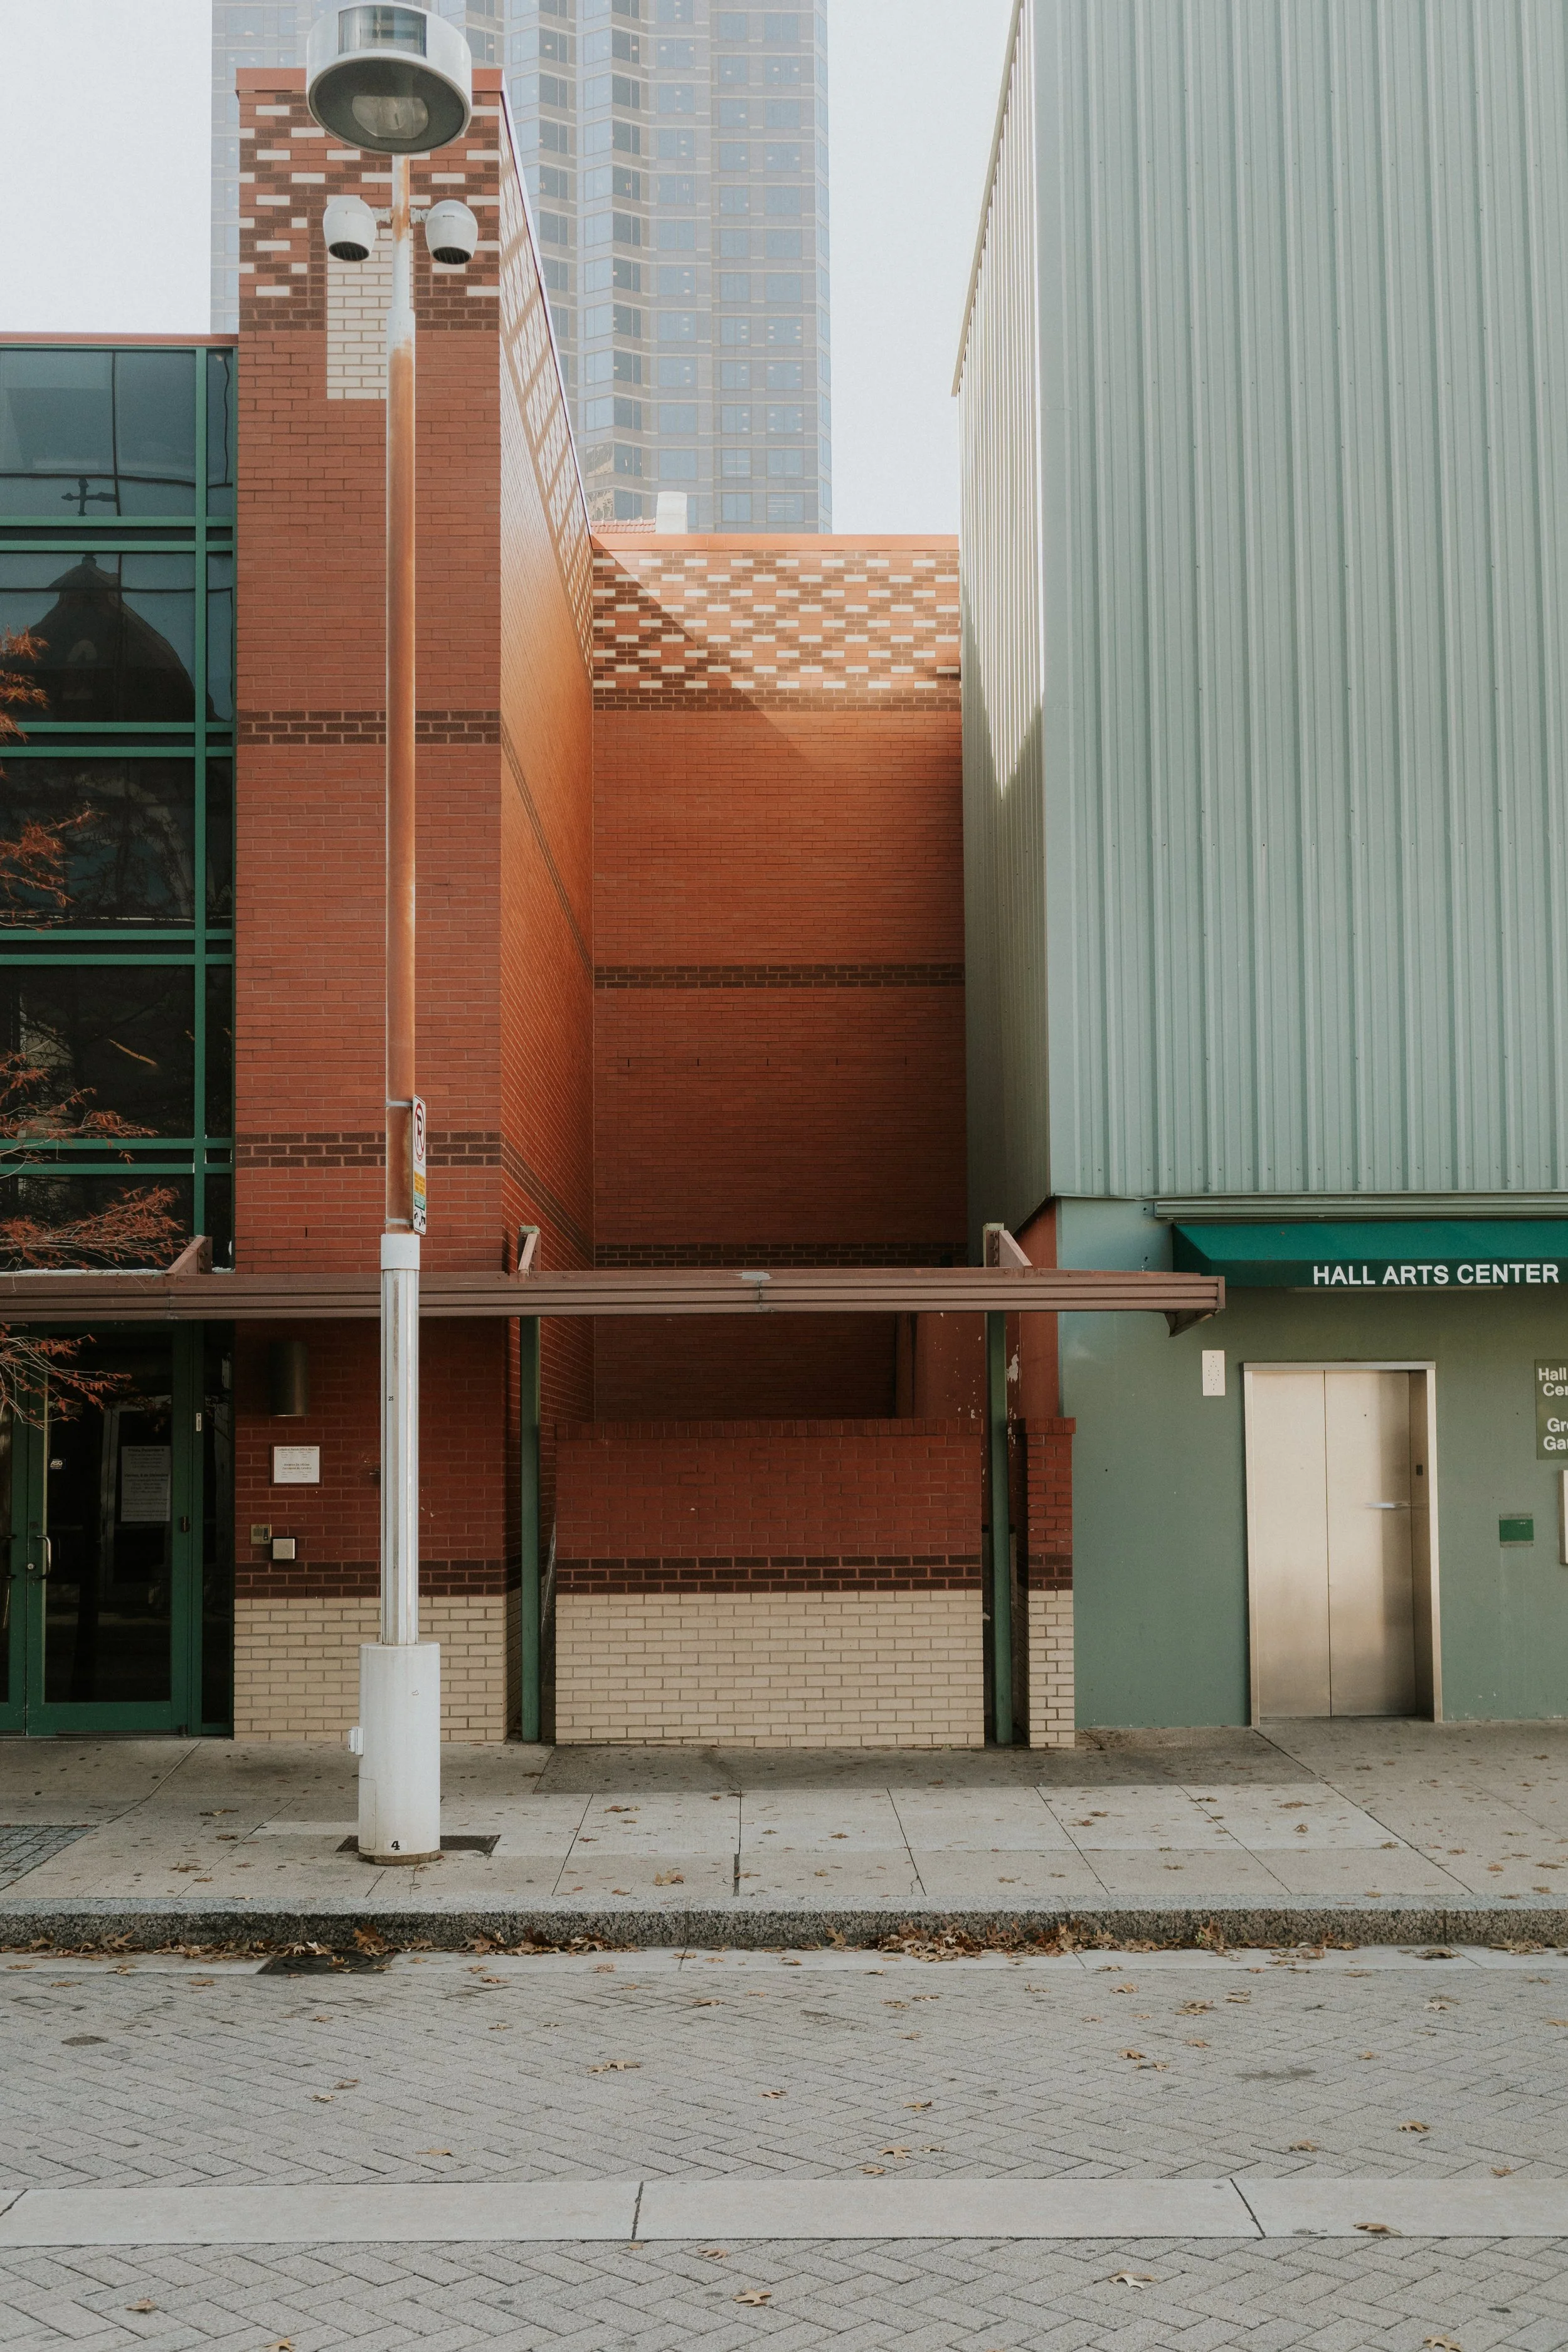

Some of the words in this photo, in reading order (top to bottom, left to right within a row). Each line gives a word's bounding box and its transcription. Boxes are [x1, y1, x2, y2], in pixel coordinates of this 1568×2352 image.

[1313, 1266, 1375, 1285] HALL
[1382, 1264, 1449, 1285] ARTS
[1457, 1264, 1559, 1284] CENTER
[1539, 1367, 1567, 1381] Hall
[1547, 1417, 1568, 1433] Gr
[1543, 1435, 1568, 1451] Ga
[391, 1840, 400, 1850] 4
